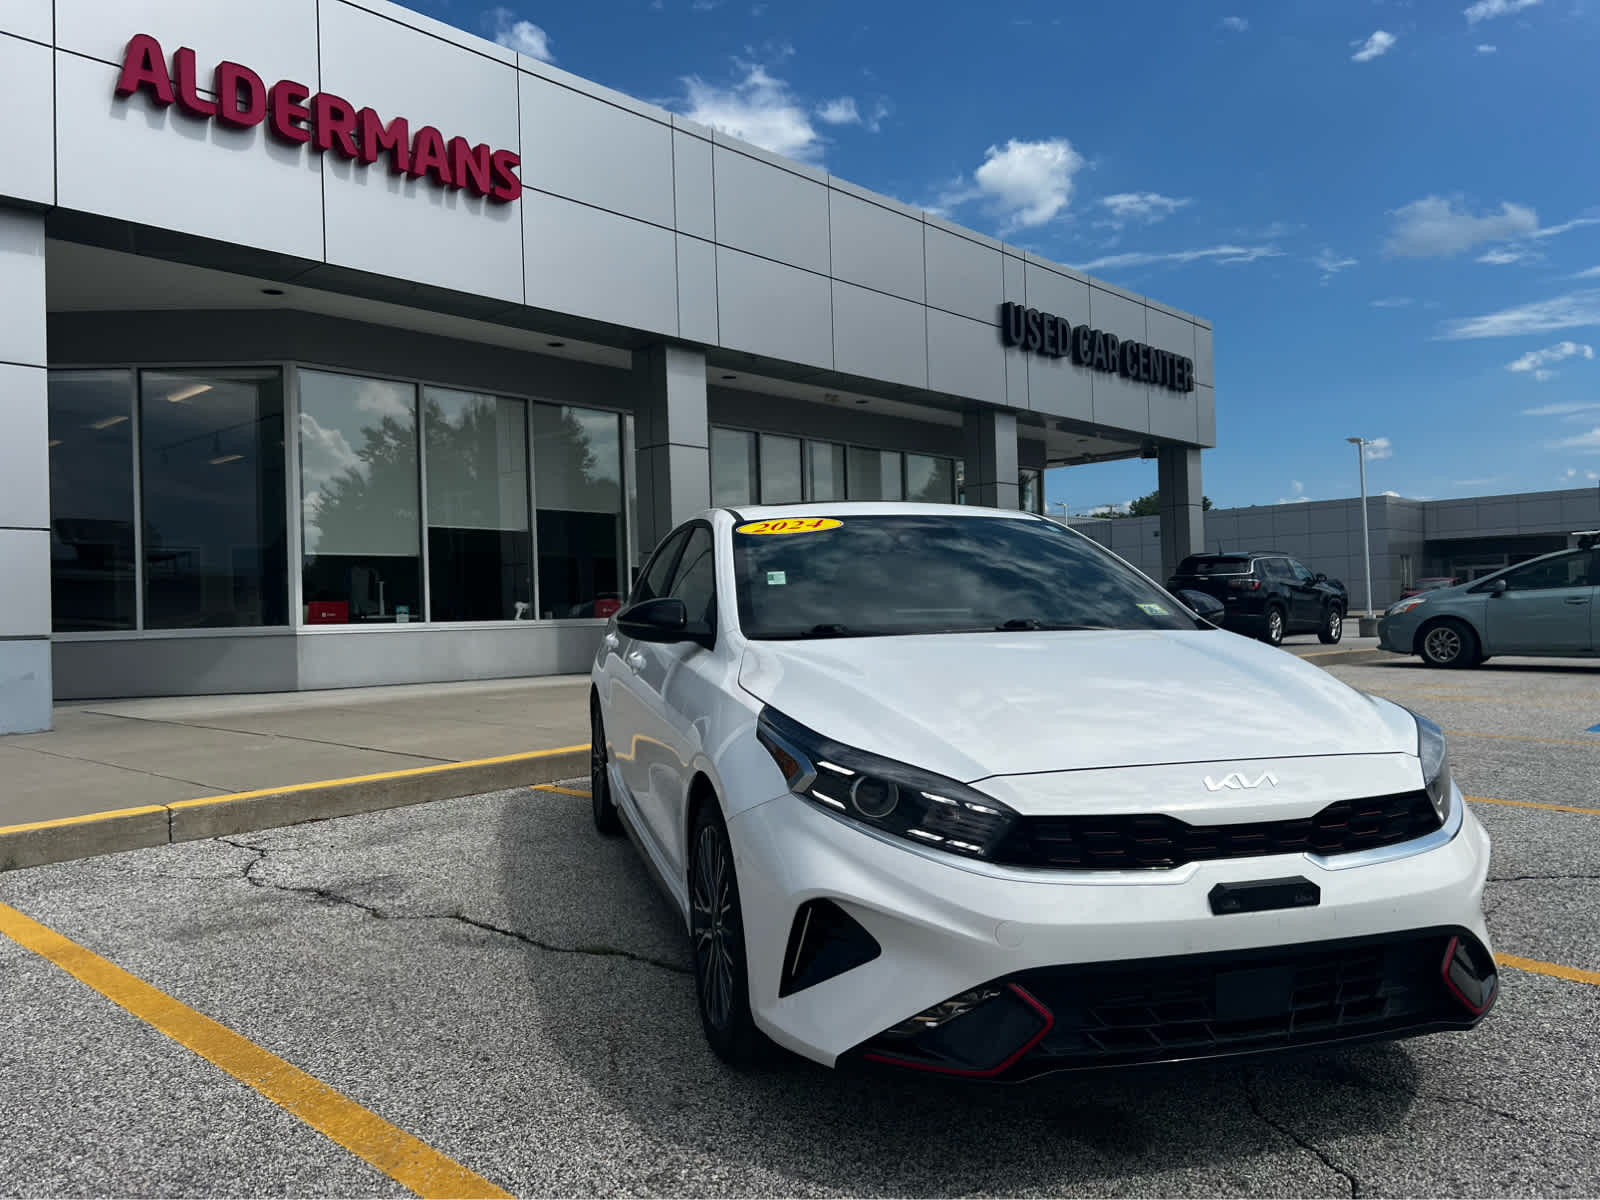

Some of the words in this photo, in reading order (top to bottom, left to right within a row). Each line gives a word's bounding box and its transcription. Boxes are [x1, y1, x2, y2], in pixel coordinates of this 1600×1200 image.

[116, 33, 522, 202] ALDERMANS
[1001, 301, 1071, 358] USED
[1072, 324, 1120, 373] CAR
[1119, 339, 1194, 392] CENTER
[752, 519, 824, 533] 2024
[1202, 772, 1279, 792] KIA
